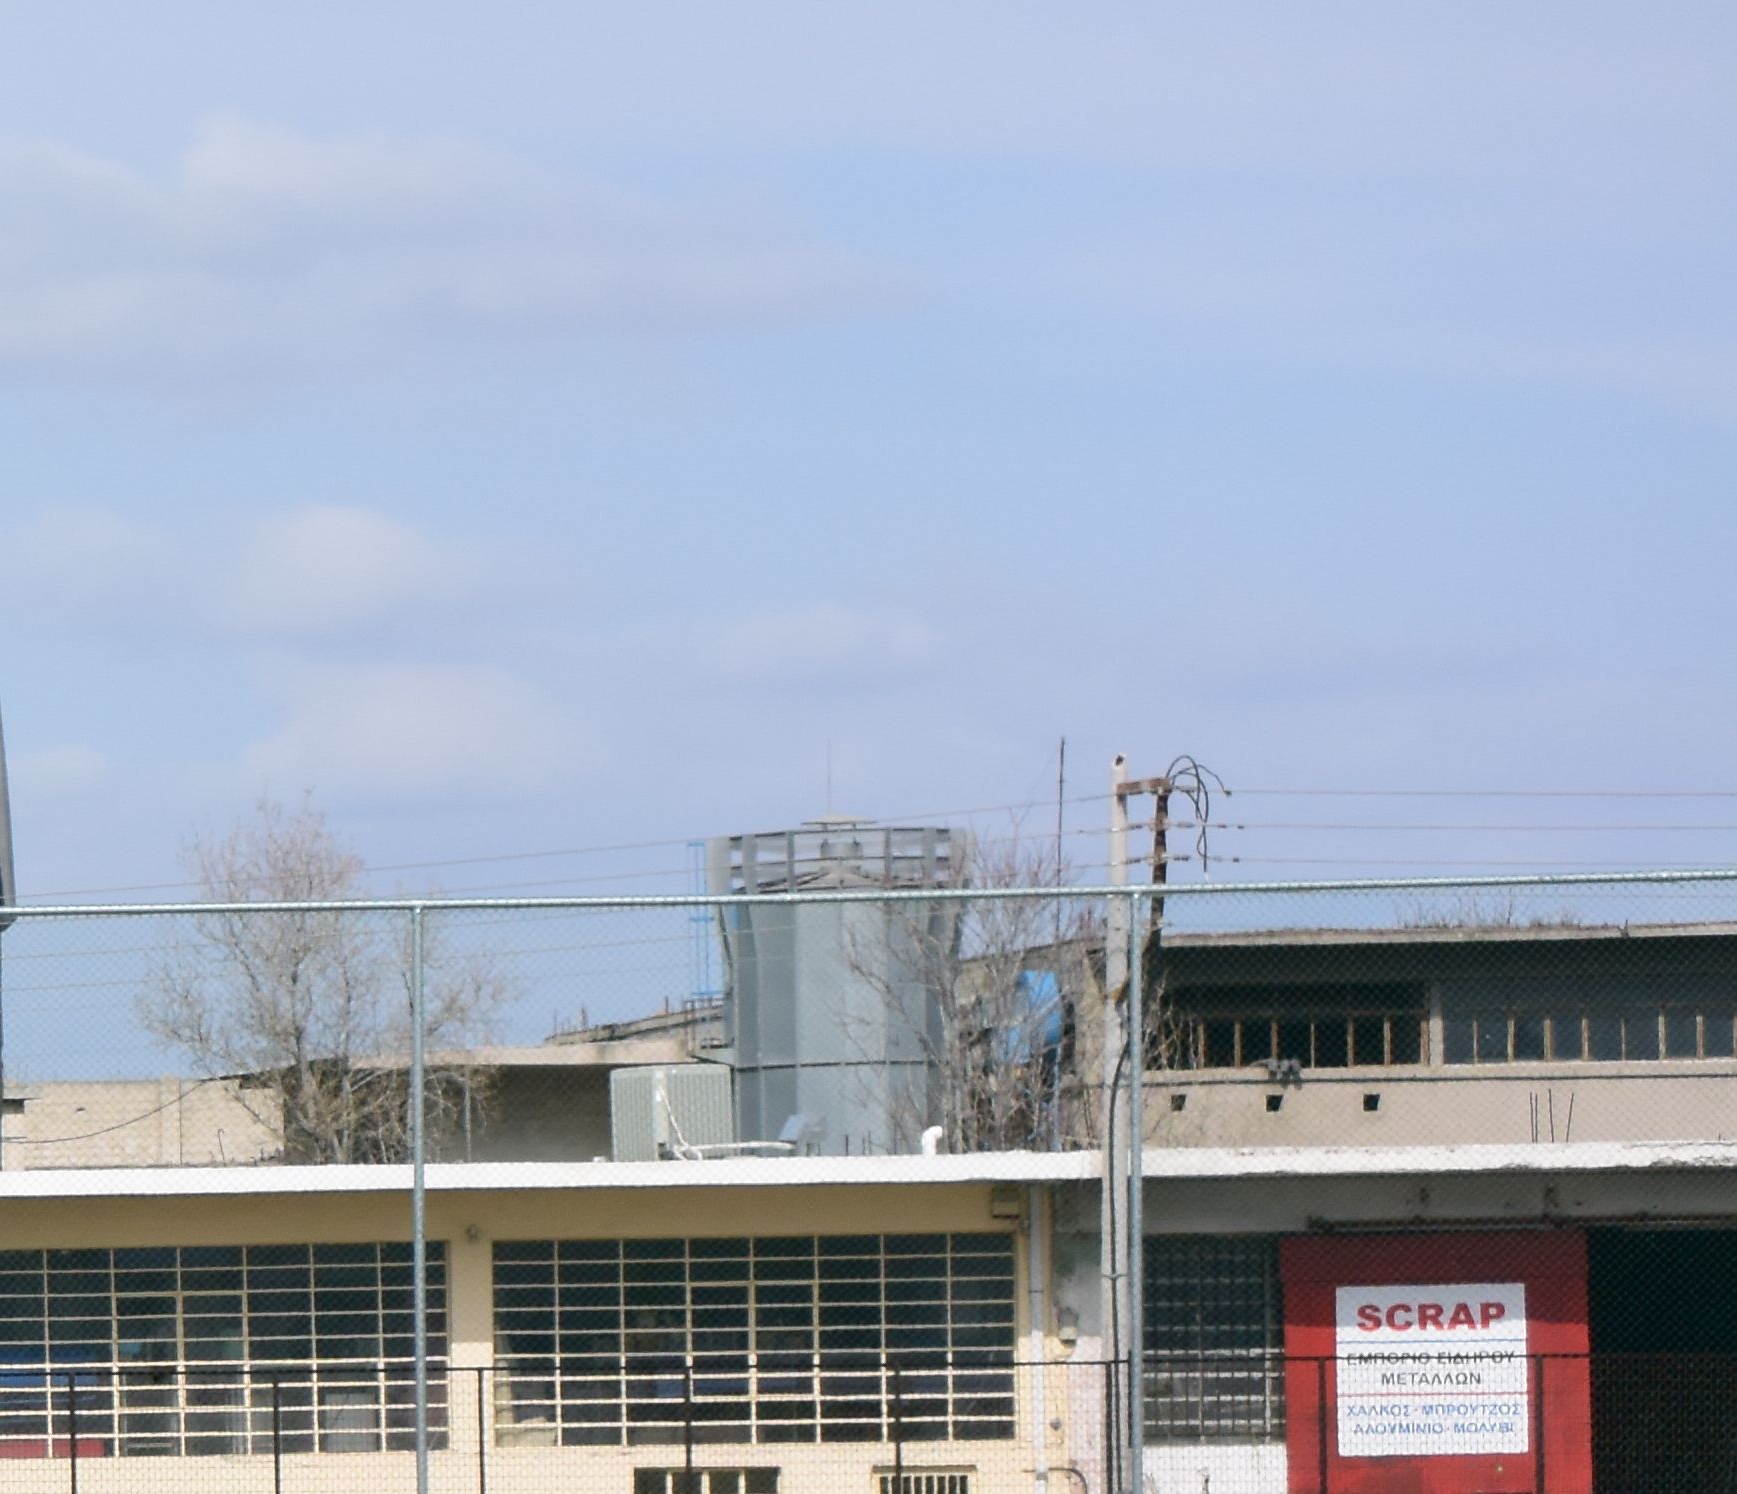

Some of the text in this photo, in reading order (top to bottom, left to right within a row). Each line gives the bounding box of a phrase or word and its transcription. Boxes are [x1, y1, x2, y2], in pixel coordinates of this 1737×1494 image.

[1356, 1302, 1506, 1332] SCRAP
[1381, 1372, 1482, 1386] ΜΕΤΑΛΛΩΝ
[1347, 1404, 1411, 1417] ΧΑΛΚΟΣ
